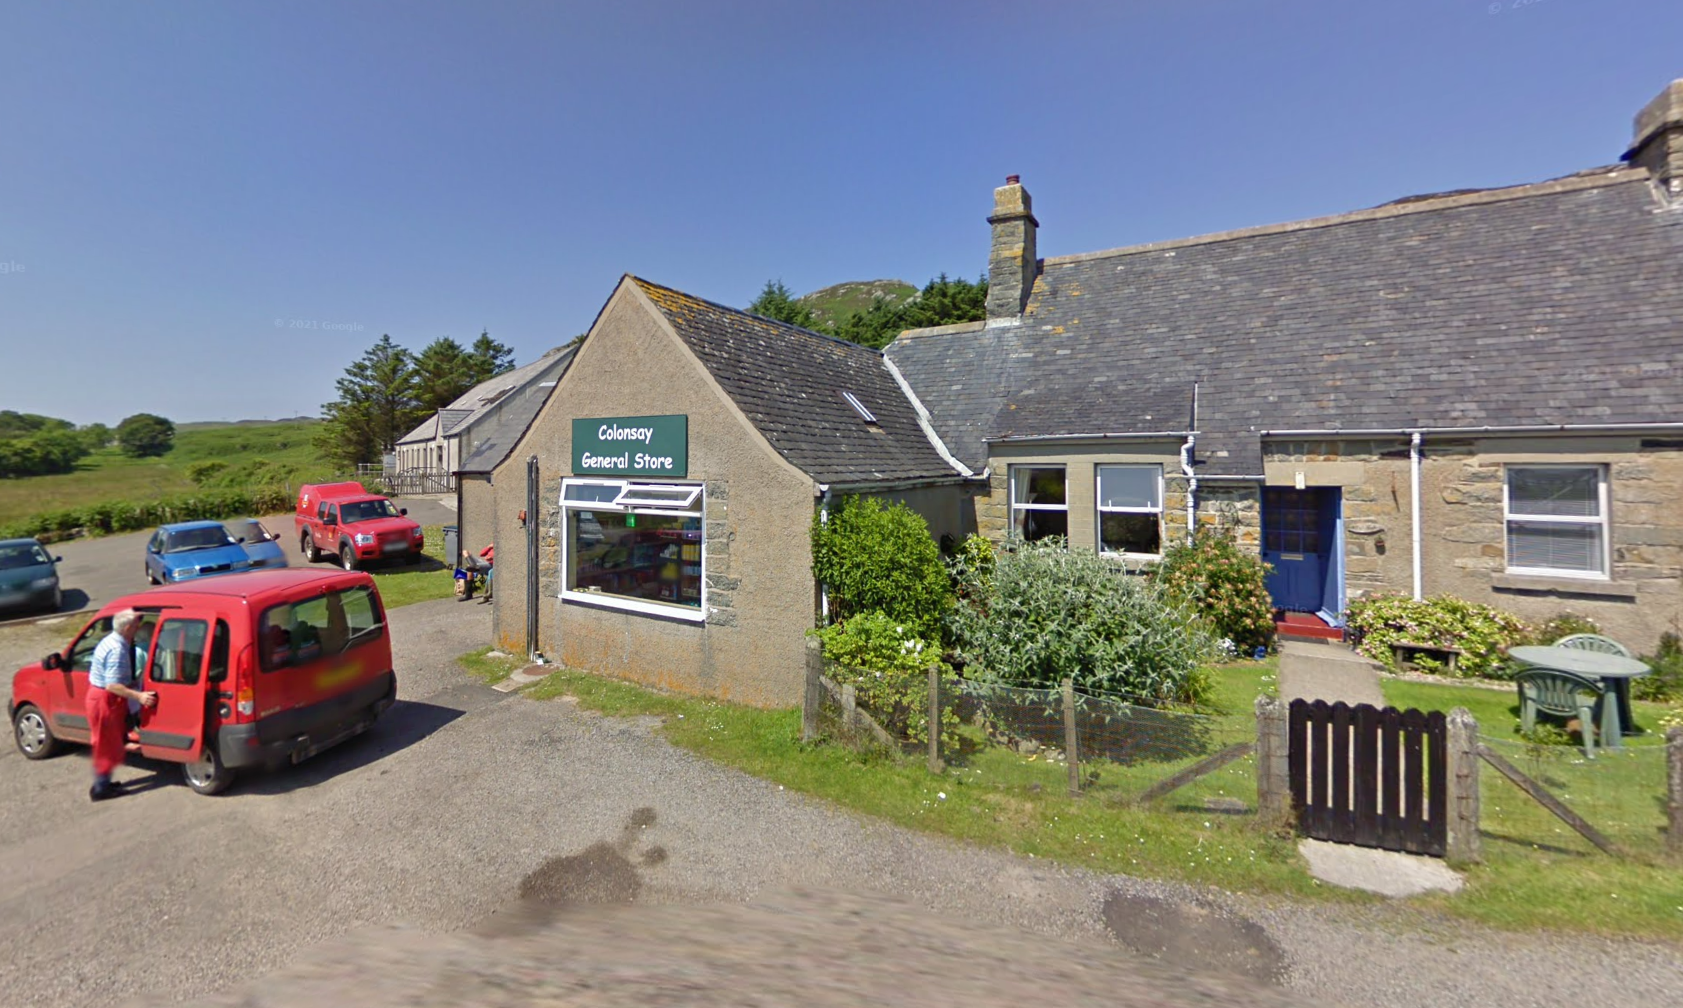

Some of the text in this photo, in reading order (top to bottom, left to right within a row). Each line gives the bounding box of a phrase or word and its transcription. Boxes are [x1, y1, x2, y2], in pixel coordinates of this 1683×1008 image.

[598, 423, 653, 444] Colonsay
[582, 451, 673, 469] General Store
